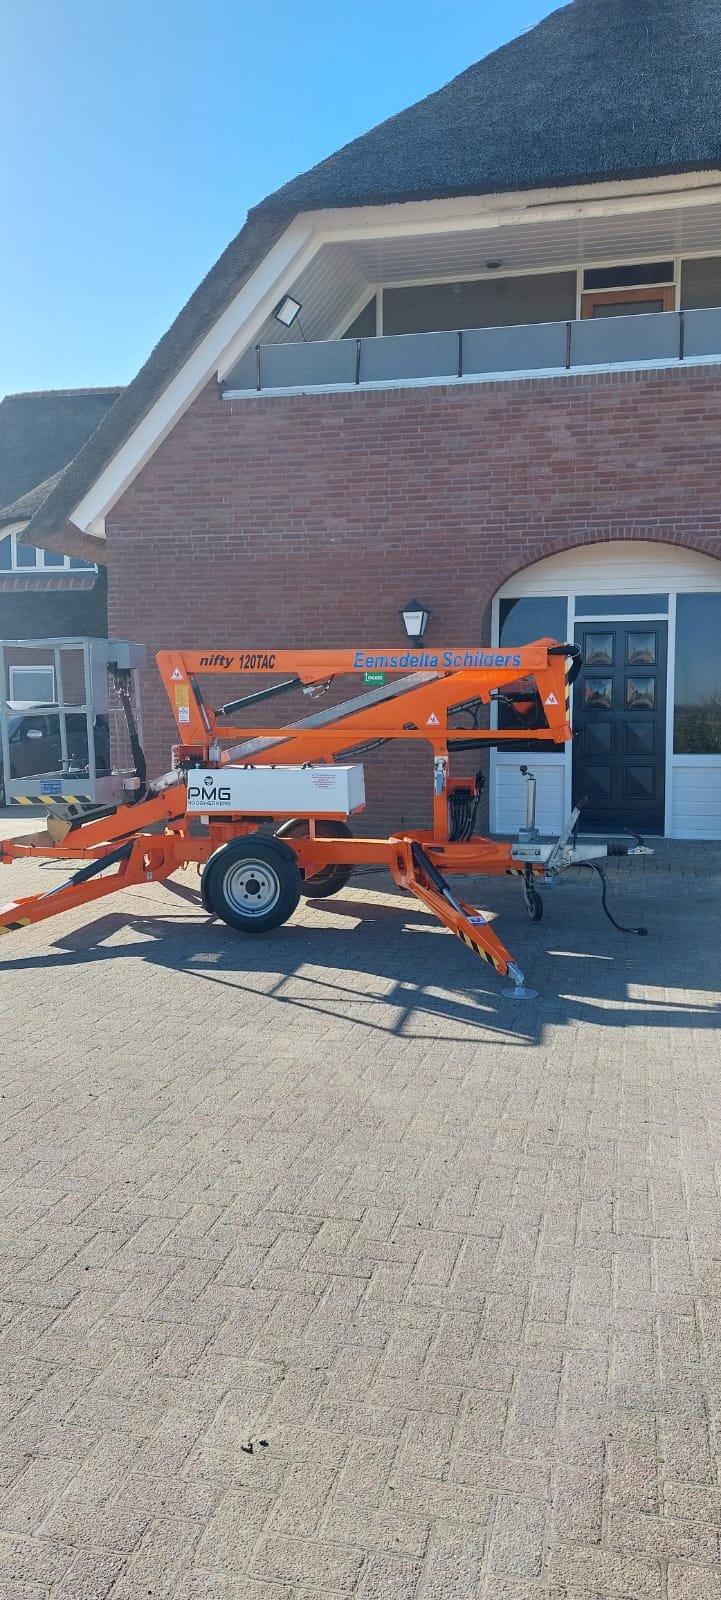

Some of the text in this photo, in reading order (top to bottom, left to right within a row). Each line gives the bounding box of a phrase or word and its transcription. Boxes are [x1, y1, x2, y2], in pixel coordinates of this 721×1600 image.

[199, 654, 276, 669] nifty 120TAC
[353, 651, 521, 669] Eemsdelta Schilders
[187, 787, 231, 800] PMG
